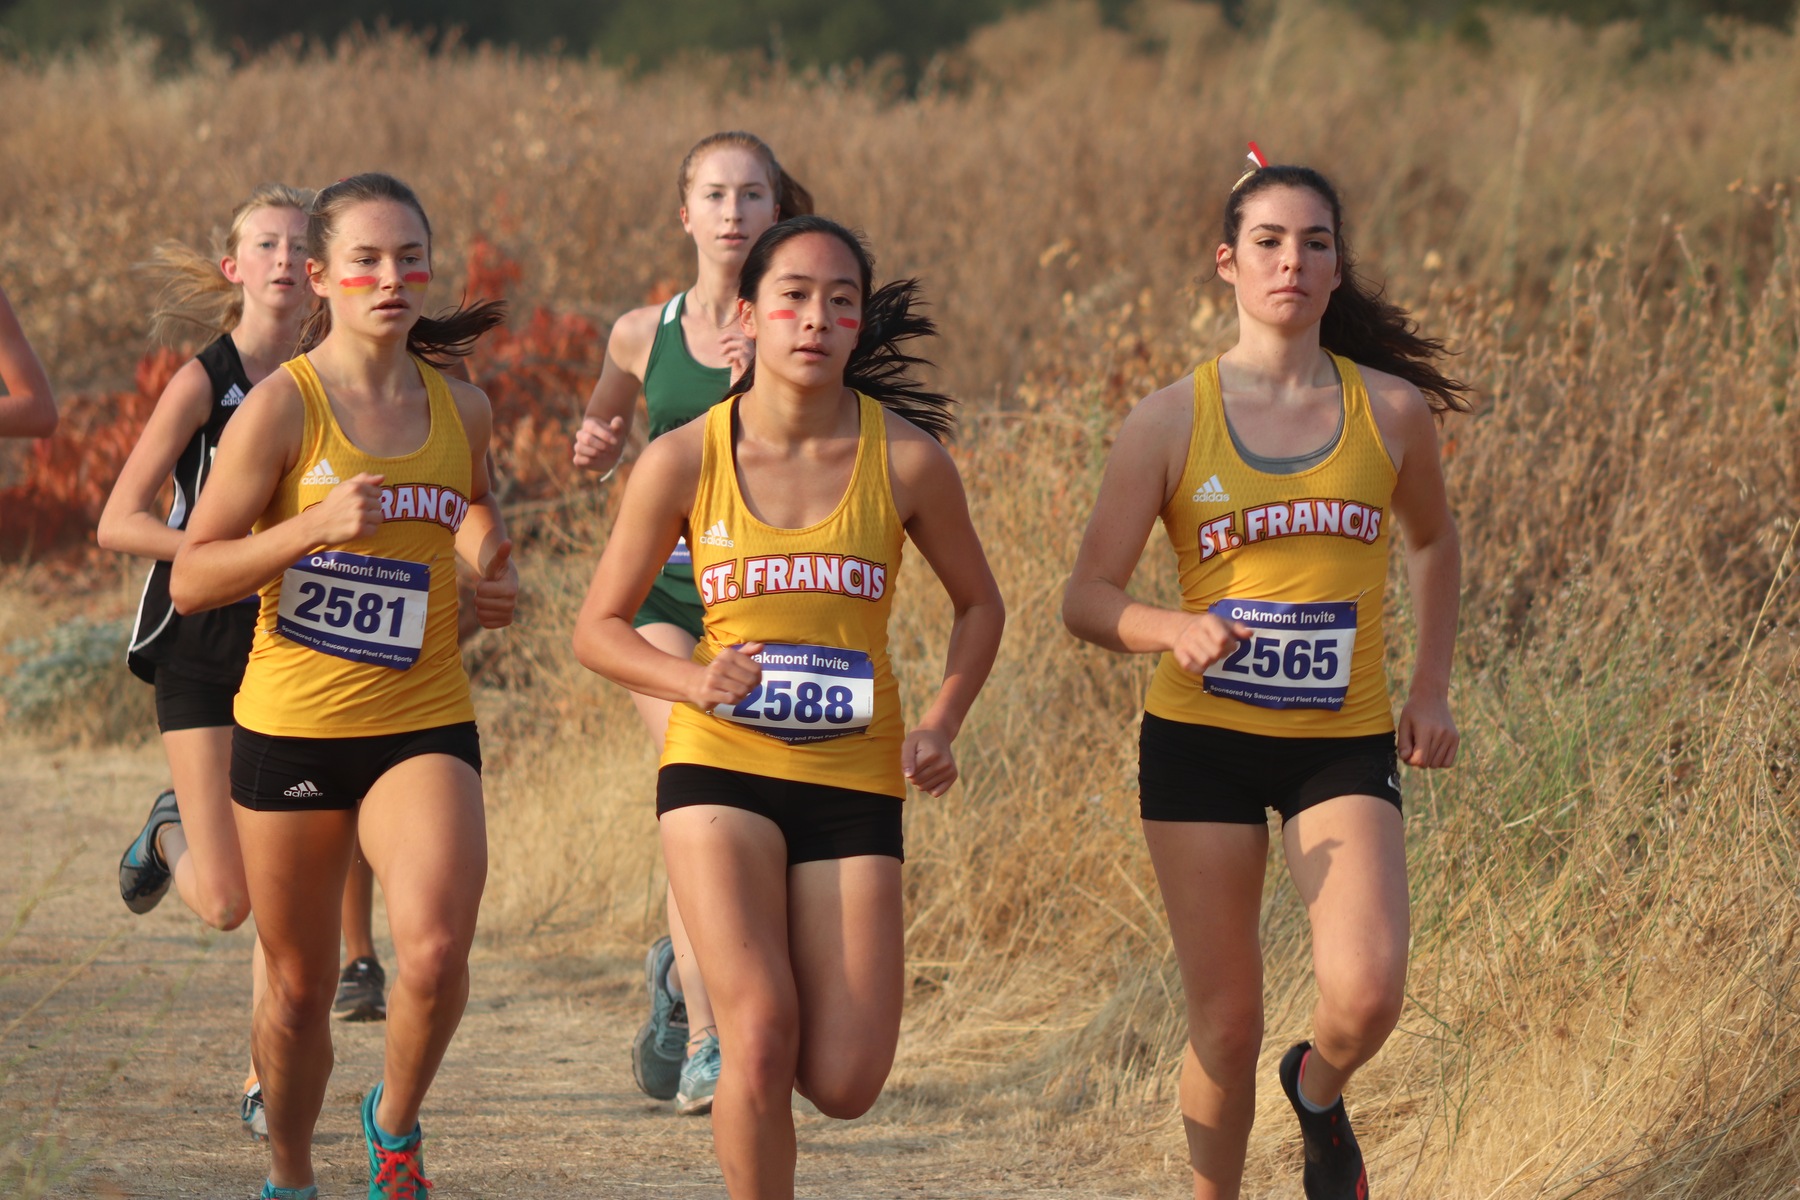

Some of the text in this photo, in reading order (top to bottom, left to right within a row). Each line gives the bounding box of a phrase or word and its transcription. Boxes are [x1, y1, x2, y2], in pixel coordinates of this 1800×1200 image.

[220, 398, 244, 406] adid
[302, 476, 340, 485] adidas
[380, 485, 468, 534] RANCIS
[1192, 493, 1230, 503] adidas
[699, 534, 734, 548] adidas
[1199, 498, 1383, 563] ST. FRANCIS
[311, 556, 411, 582] Oakmont Invite
[701, 552, 887, 606] ST. FRANCIS
[294, 581, 405, 638] 2581
[1231, 607, 1336, 624] Oakmont Invite
[282, 625, 312, 641] Sponsored
[312, 637, 321, 645] by
[321, 640, 349, 653] Saucony
[379, 652, 393, 660] Feet
[393, 654, 413, 663] Sports
[750, 651, 850, 671] akmont Invite
[1221, 636, 1339, 681] 2565
[732, 680, 854, 724] 2588
[1210, 685, 1244, 697] Sponsored
[1244, 690, 1253, 698] by
[1253, 692, 1282, 703] Saucony
